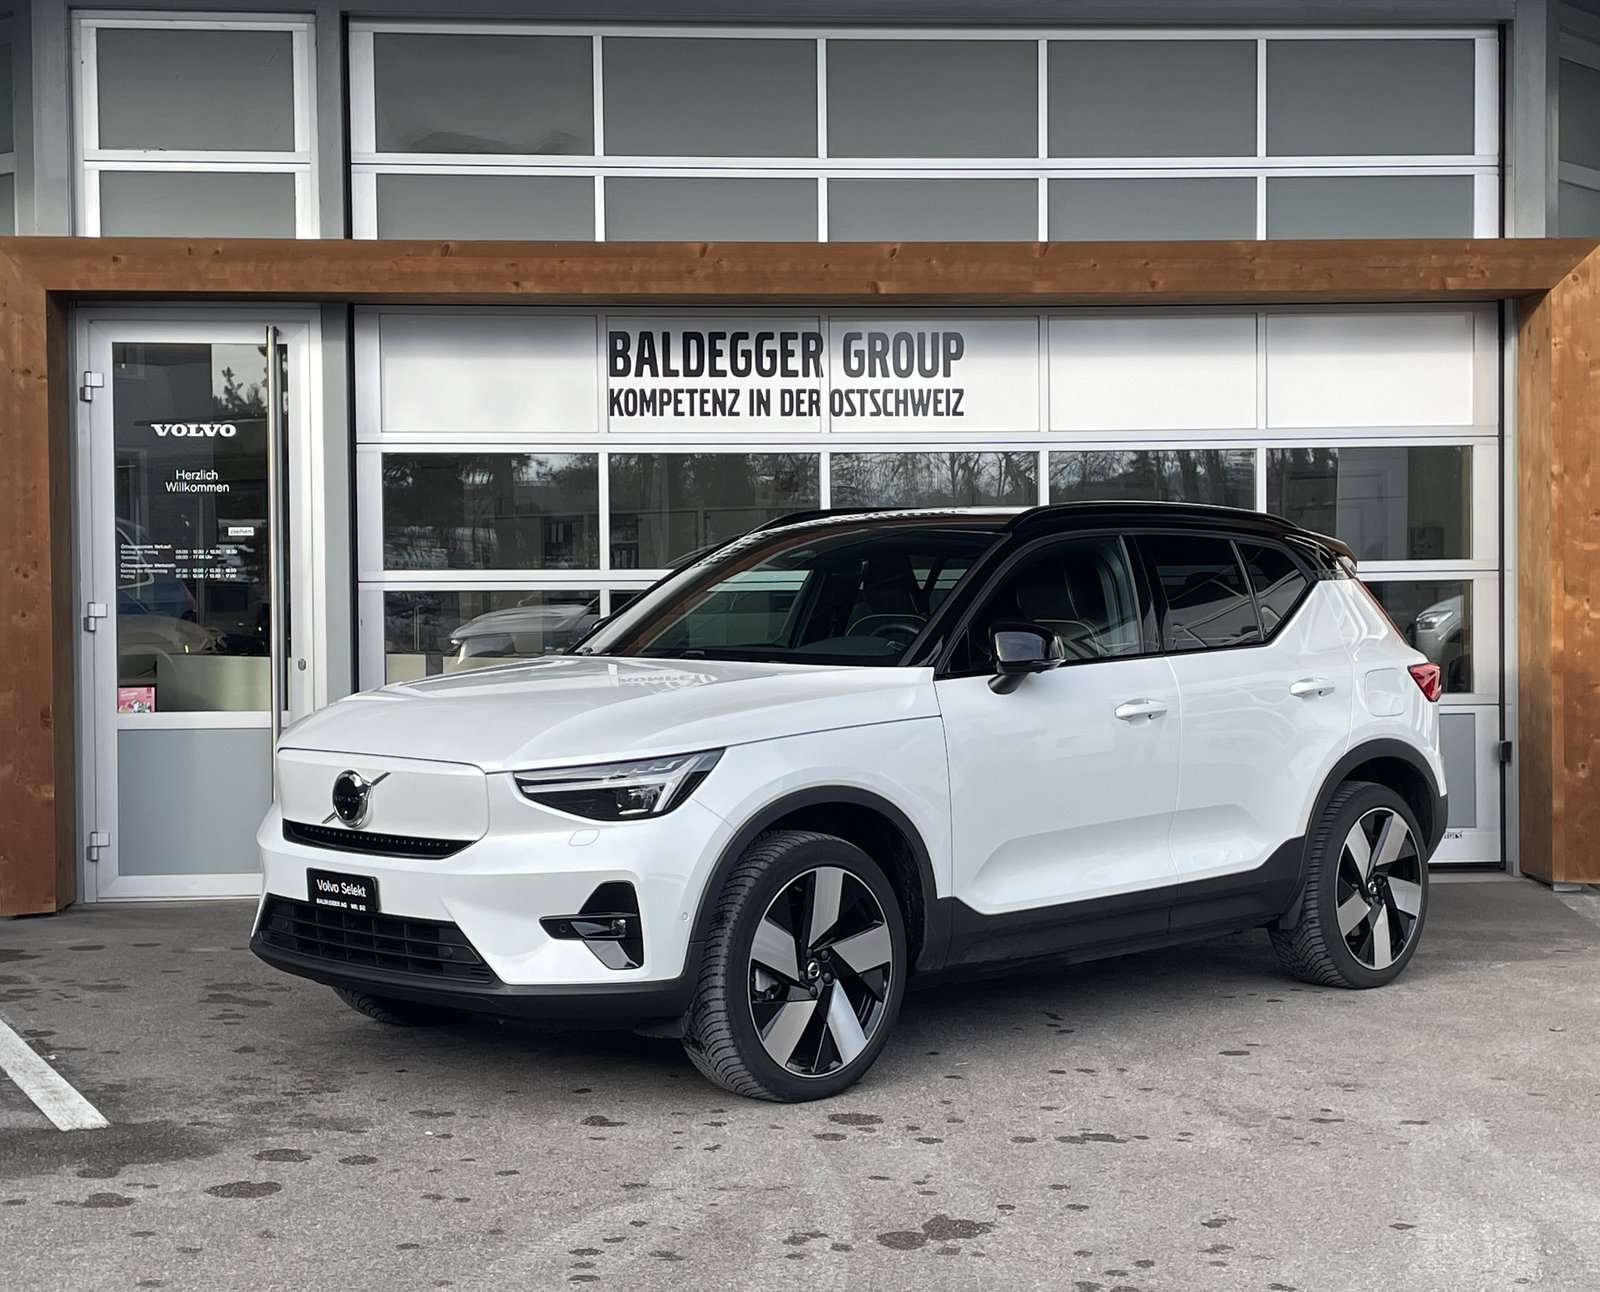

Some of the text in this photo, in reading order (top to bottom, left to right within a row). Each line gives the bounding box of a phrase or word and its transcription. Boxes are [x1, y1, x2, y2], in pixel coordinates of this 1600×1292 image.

[608, 331, 964, 379] BALDEGGER GROUP
[609, 388, 965, 418] KOMPETENZ IN DER OSTSCHWEIZ
[150, 423, 237, 437] VOLVO
[175, 469, 219, 481] Herzlich
[165, 481, 230, 493] Willkommen
[316, 878, 367, 897] Volvo Selekt
